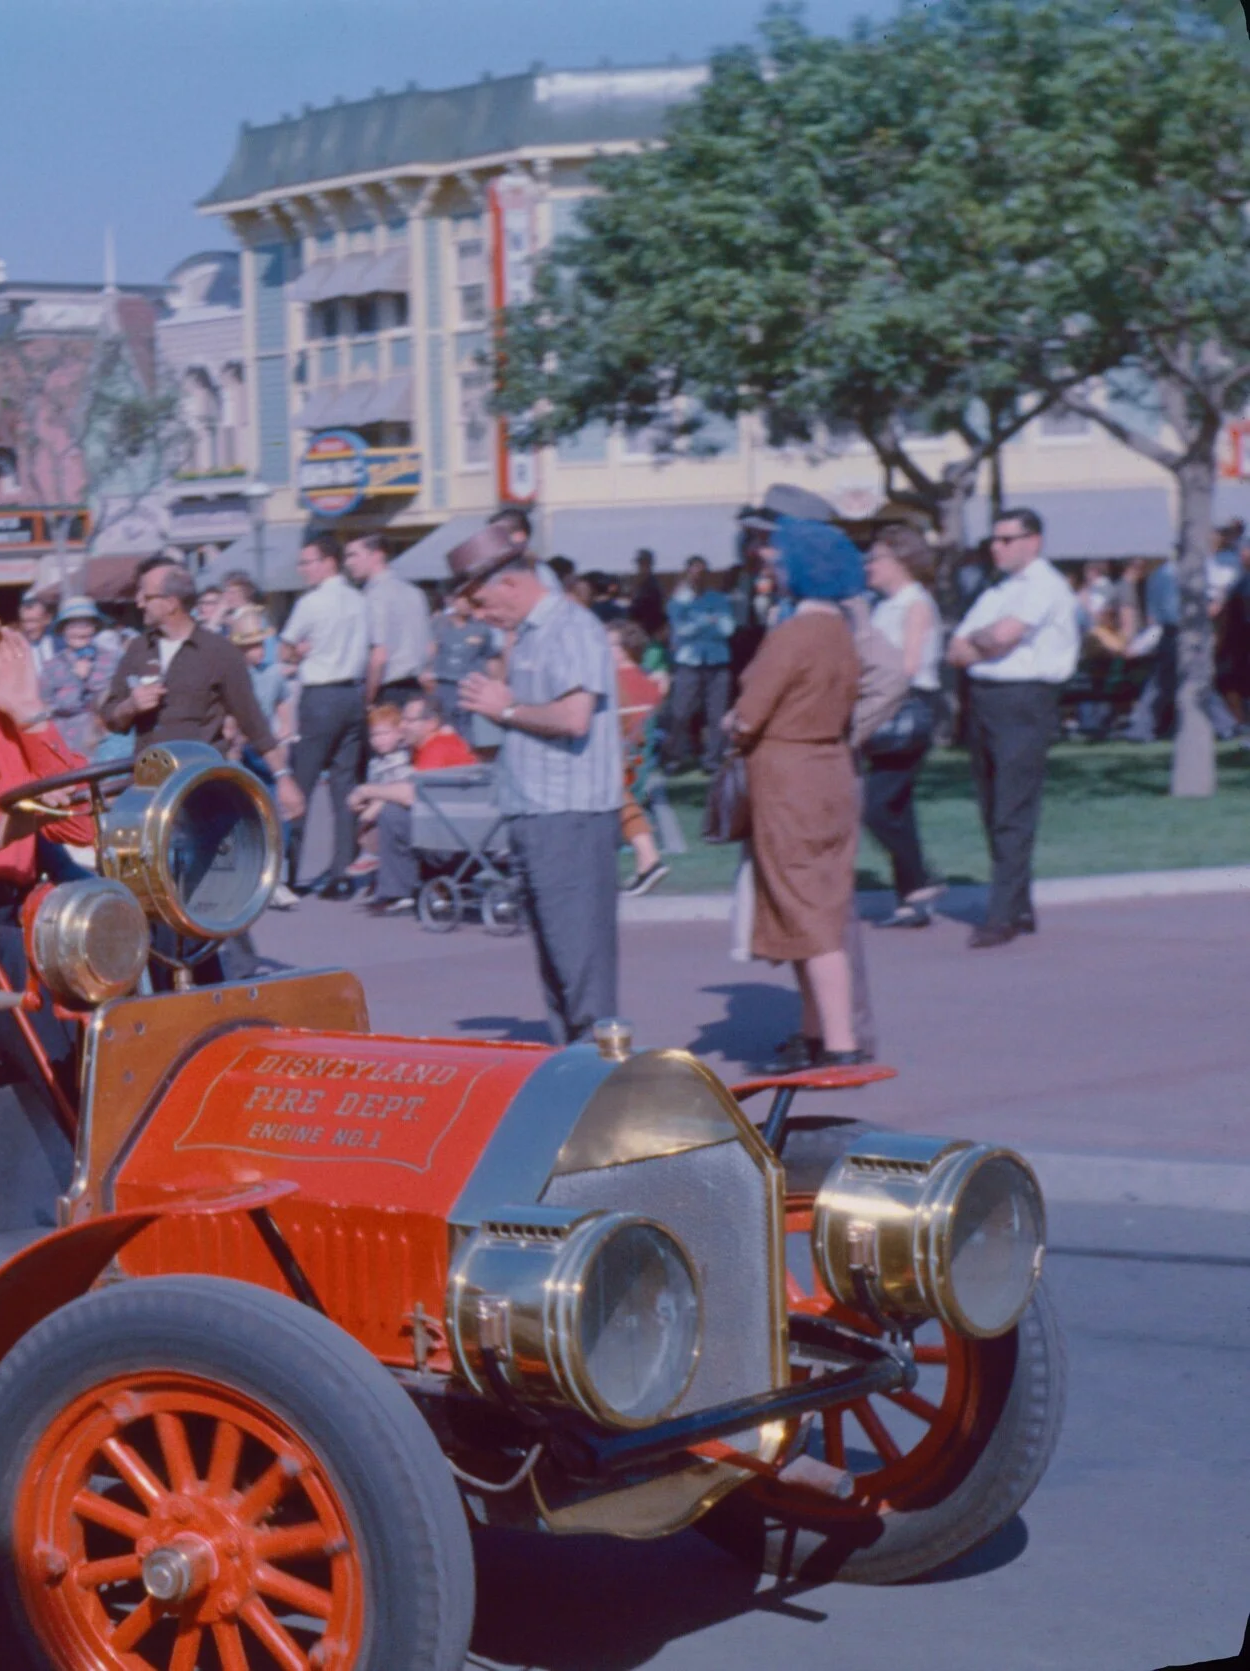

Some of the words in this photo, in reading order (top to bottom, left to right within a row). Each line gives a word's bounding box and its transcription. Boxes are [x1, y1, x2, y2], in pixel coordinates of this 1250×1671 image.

[254, 1055, 458, 1085] DISNEYLAND
[244, 1086, 325, 1114] FIRE
[334, 1092, 425, 1121] DEPT.
[248, 1121, 324, 1144] ENGINE
